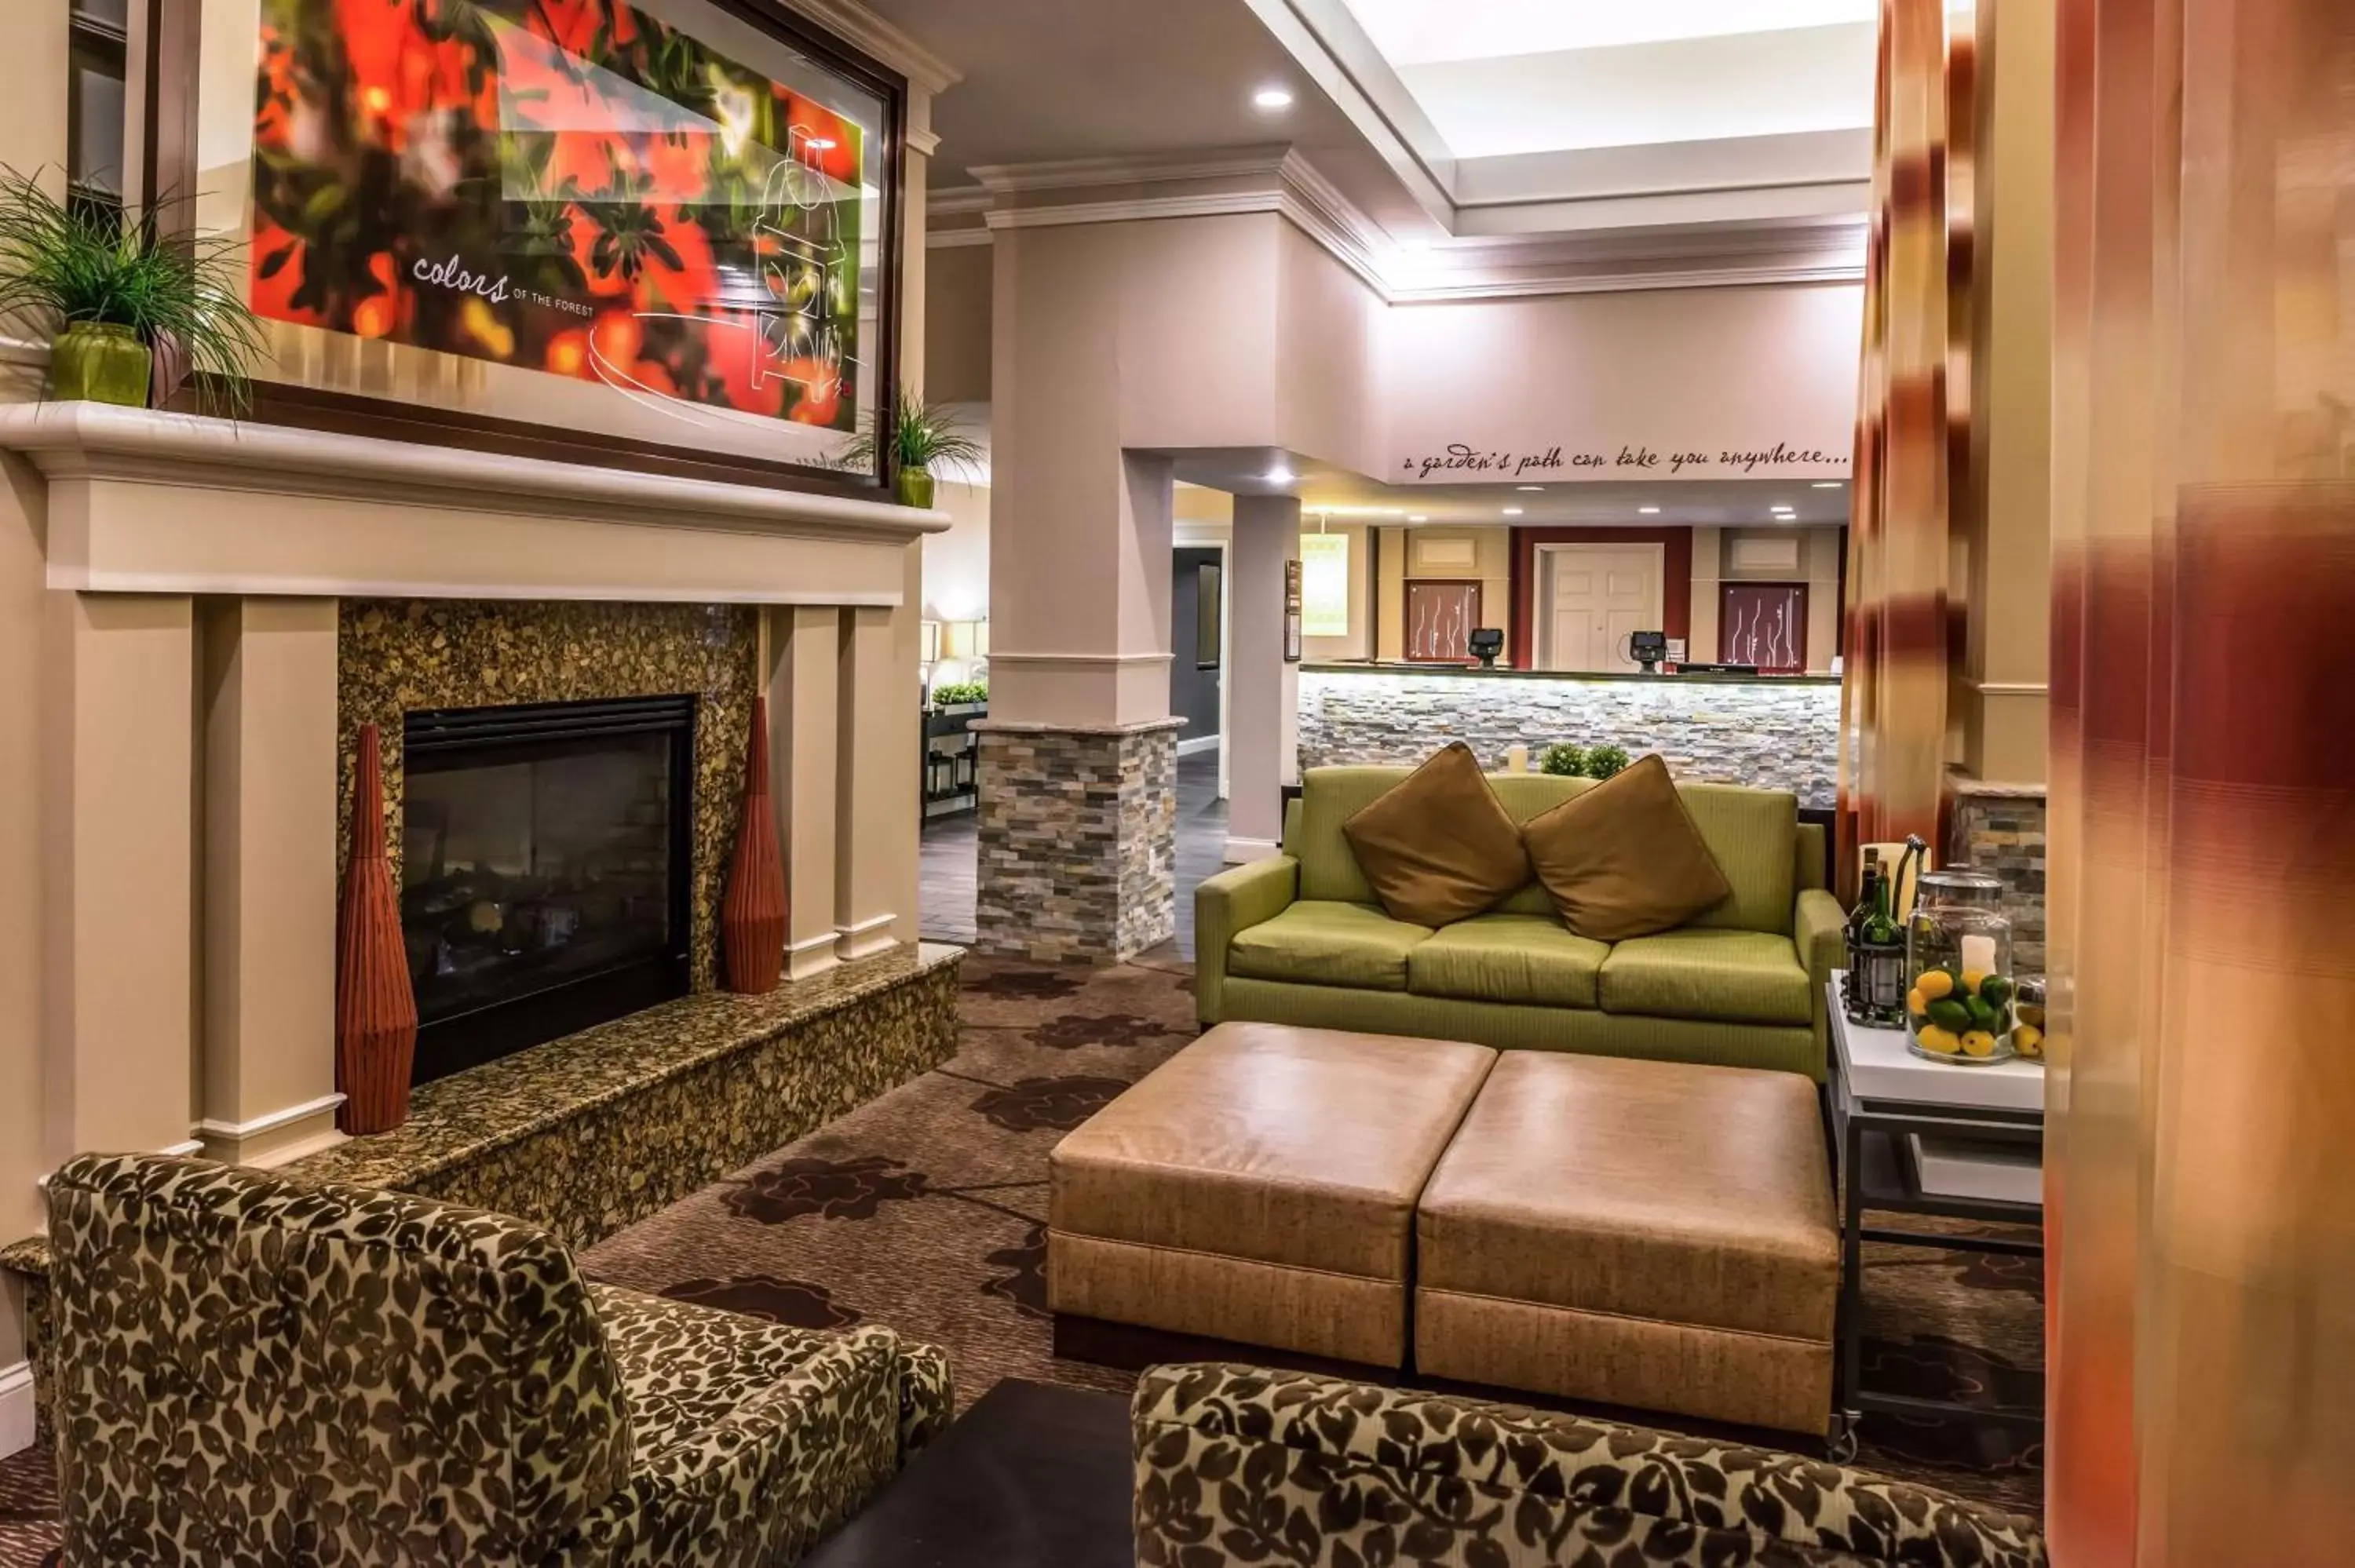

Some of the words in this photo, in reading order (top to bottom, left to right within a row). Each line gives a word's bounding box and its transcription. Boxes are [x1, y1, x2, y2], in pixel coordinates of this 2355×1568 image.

[413, 253, 509, 304] colors
[513, 288, 527, 300] OF
[532, 293, 551, 307] THE
[556, 299, 593, 317] FOREST
[1404, 458, 1415, 469] a
[1419, 443, 1511, 479] garden's
[1515, 446, 1564, 476] path
[1572, 453, 1606, 467] can
[1617, 445, 1659, 469] take
[1671, 451, 1710, 473] you
[1721, 442, 1848, 472] anywhere...
